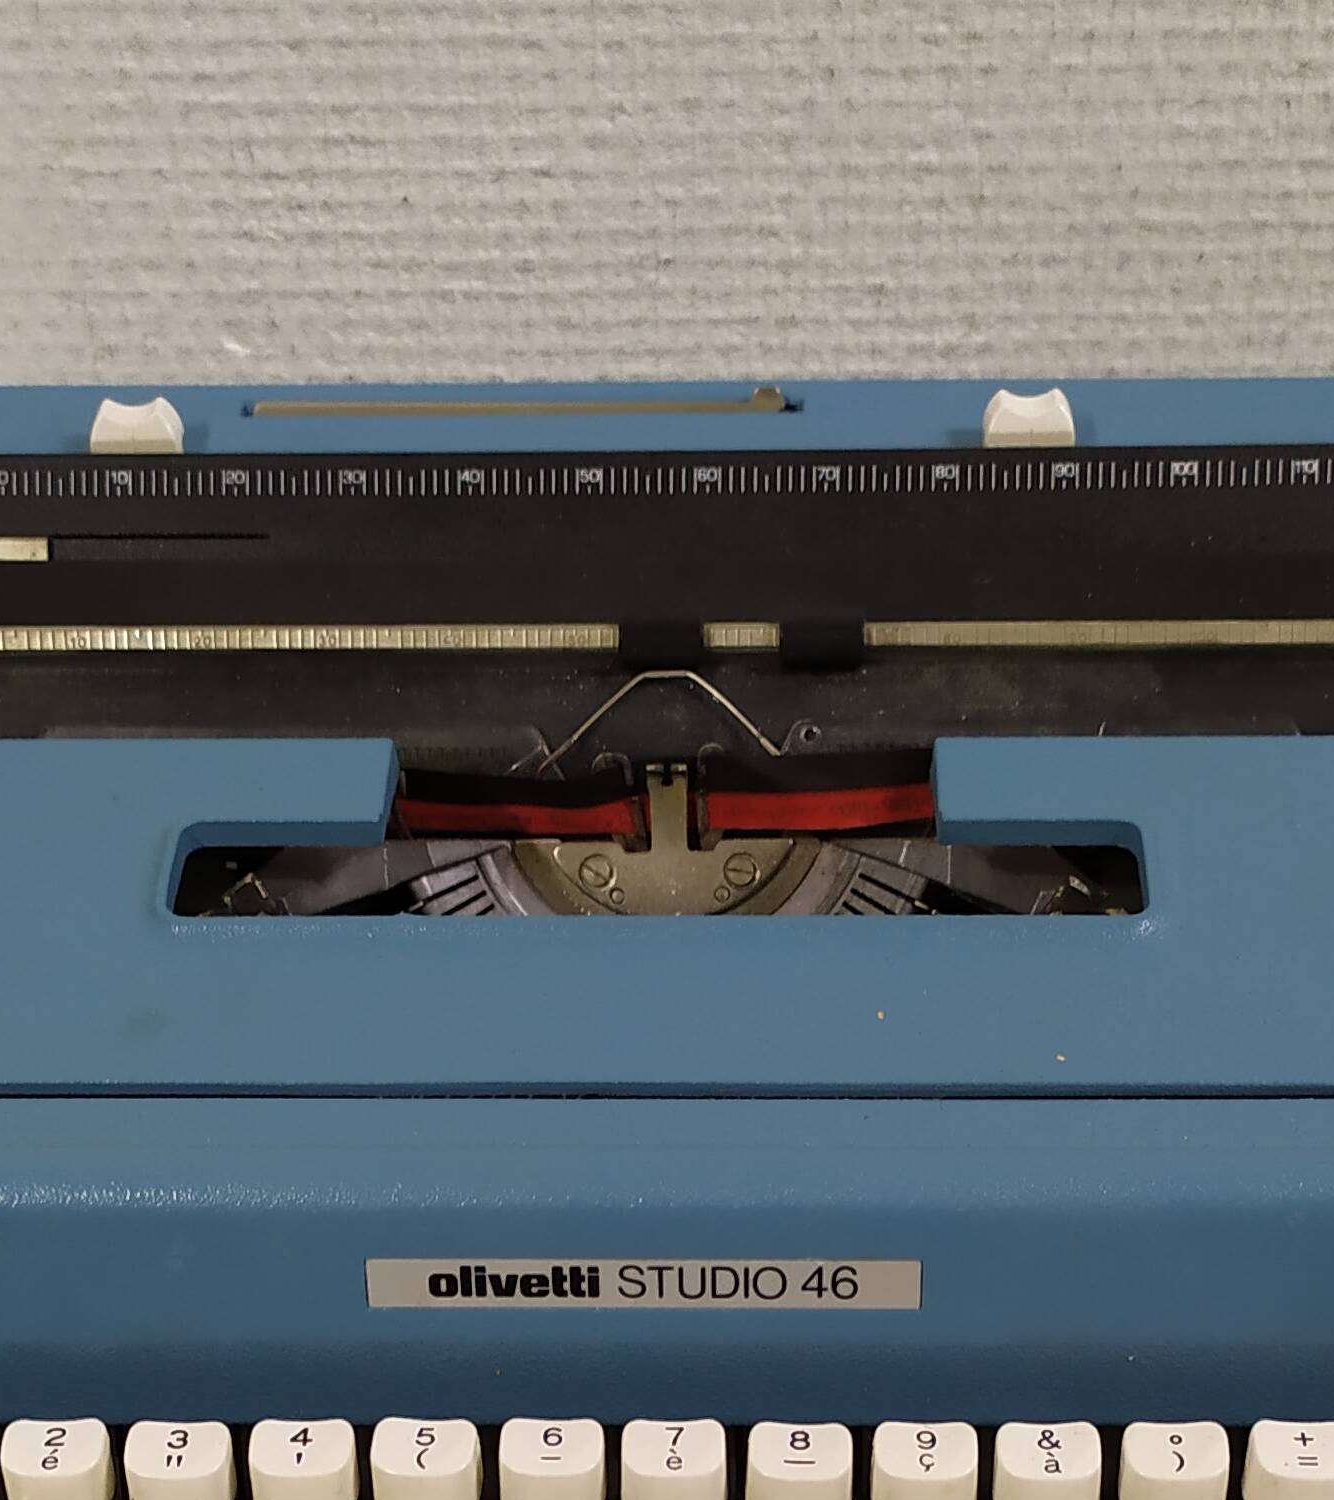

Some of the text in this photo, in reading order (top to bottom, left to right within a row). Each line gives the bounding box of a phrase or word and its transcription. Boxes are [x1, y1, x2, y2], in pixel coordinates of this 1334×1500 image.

[111, 469, 129, 485] 10
[225, 469, 246, 485] 20
[343, 469, 364, 485] 30
[460, 468, 481, 484] 40
[579, 467, 600, 483] 50
[697, 466, 718, 482] 60
[817, 465, 837, 482] 70
[935, 464, 956, 480] 80
[1054, 463, 1075, 479] 90
[1172, 461, 1196, 477] 100
[1295, 459, 1318, 475] 110
[428, 1265, 859, 1299] olivetti STUDIO 46
[44, 1428, 66, 1446] 2
[167, 1430, 188, 1449] 3
[290, 1428, 312, 1446] 4
[416, 1428, 435, 1446] 5
[543, 1428, 562, 1446] 6
[666, 1427, 684, 1446] 7
[790, 1430, 810, 1450] 8
[917, 1430, 936, 1449] 9
[1038, 1430, 1061, 1450] &
[42, 1449, 58, 1470] é
[666, 1448, 682, 1470] è
[1045, 1451, 1061, 1473] à
